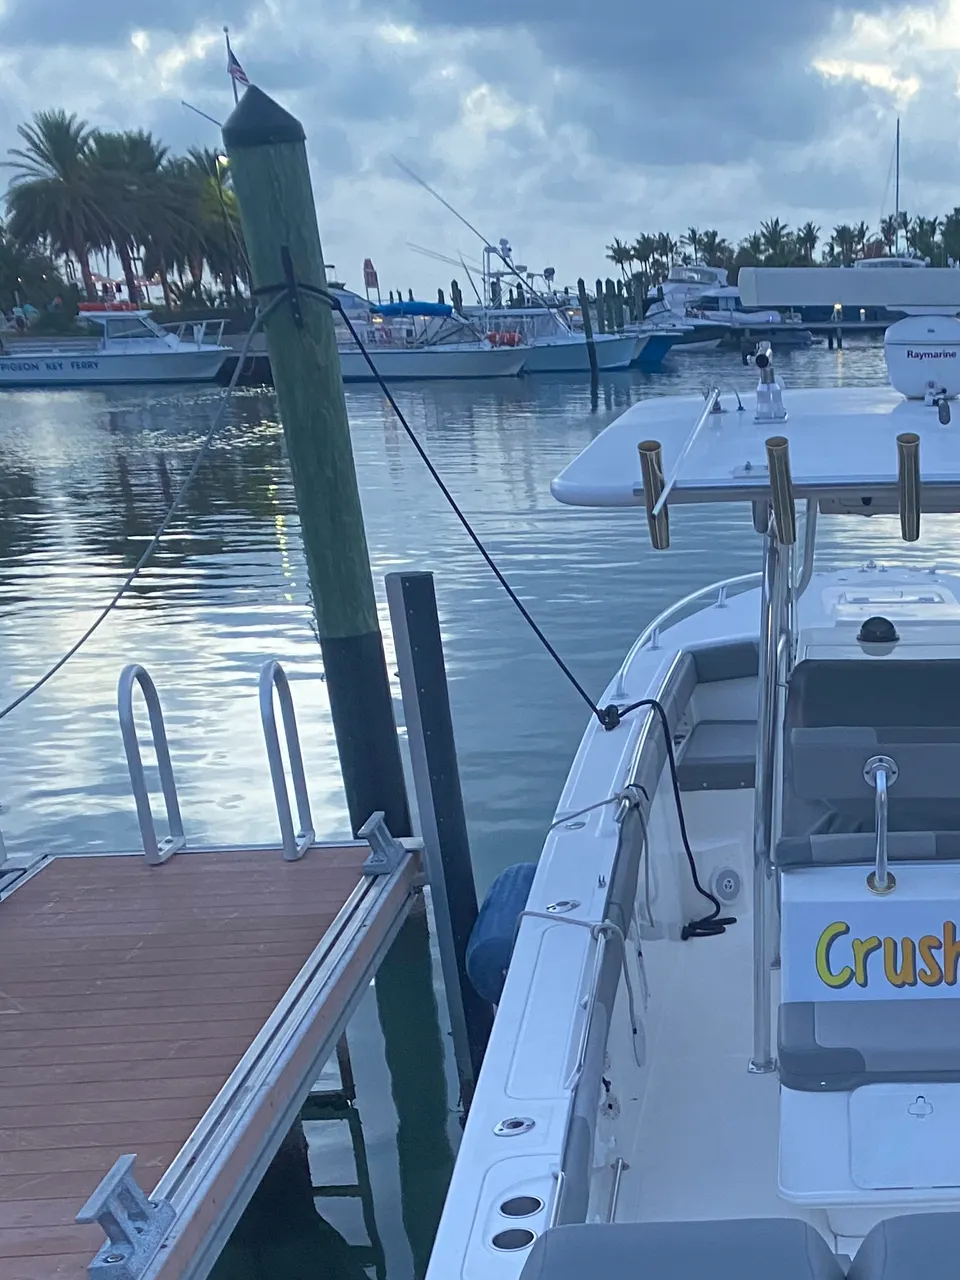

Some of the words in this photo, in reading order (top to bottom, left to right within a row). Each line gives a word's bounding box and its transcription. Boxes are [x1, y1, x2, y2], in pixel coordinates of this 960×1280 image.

[906, 349, 957, 360] Raymarine
[0, 362, 40, 371] PIGEON
[45, 361, 63, 370] KEY
[70, 360, 99, 370] FERRY
